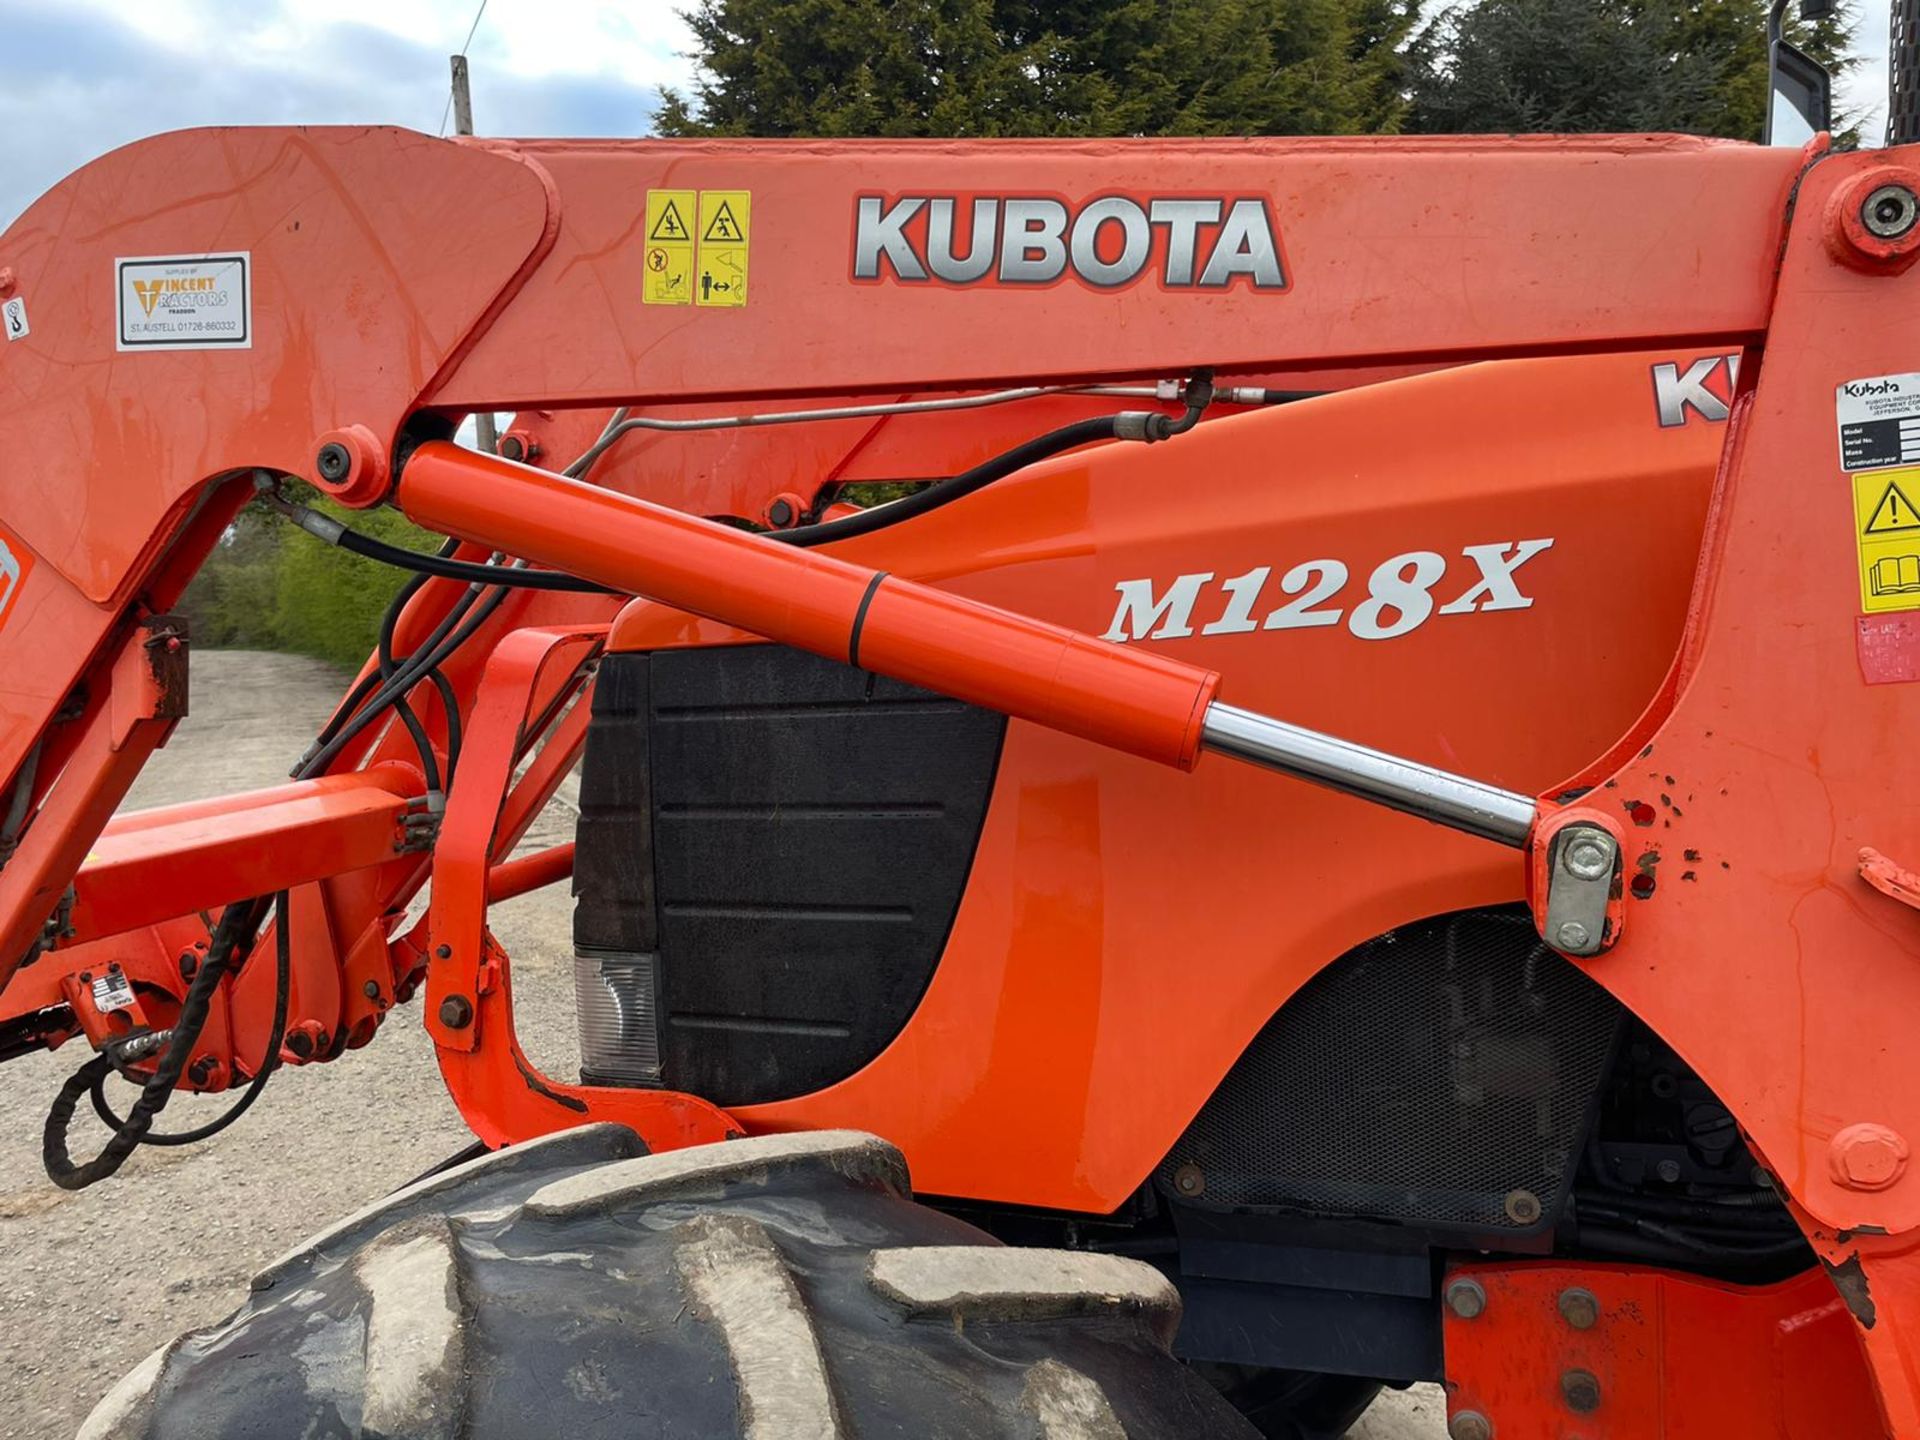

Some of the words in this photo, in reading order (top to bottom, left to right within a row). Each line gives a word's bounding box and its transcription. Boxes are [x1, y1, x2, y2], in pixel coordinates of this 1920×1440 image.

[854, 196, 1287, 288] KUBOTA
[132, 278, 216, 319] VINCENT
[140, 291, 229, 314] TRACTORS
[143, 321, 176, 333] AUSTELL
[1844, 380, 1900, 397] Kubota
[1865, 396, 1892, 406] KUBOTA
[1869, 401, 1907, 411] EQUIPMENT
[1845, 439, 1862, 447] Serial
[1846, 458, 1883, 468] Construction
[1884, 456, 1897, 465] year
[1100, 538, 1555, 642] M128X
